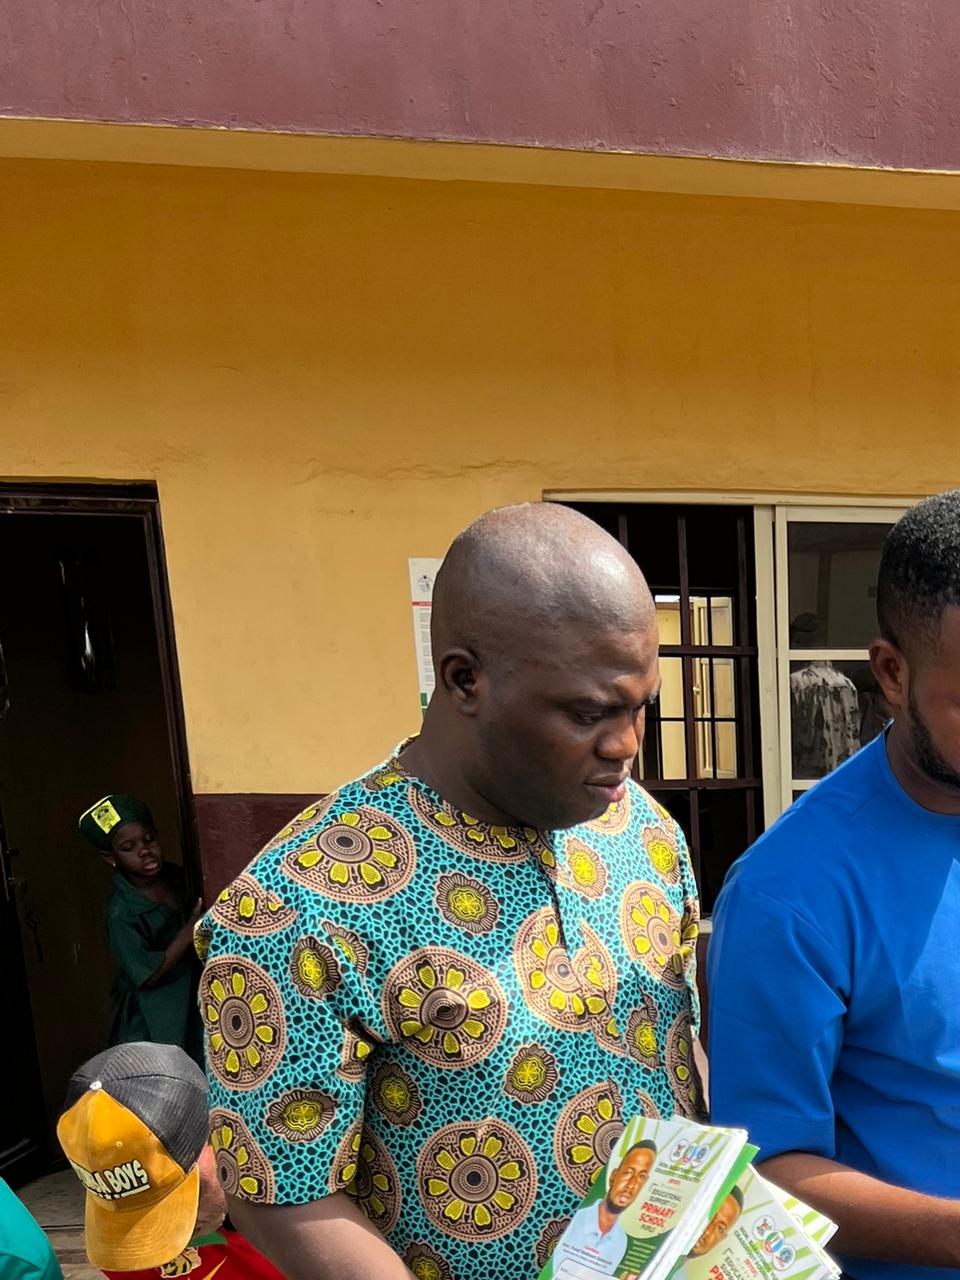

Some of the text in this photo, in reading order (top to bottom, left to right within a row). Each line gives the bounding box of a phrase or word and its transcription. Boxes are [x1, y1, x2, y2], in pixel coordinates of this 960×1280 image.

[103, 1159, 148, 1193] BOYS
[641, 1202, 676, 1219] PRIMARY
[639, 1213, 666, 1227] SCHOOL
